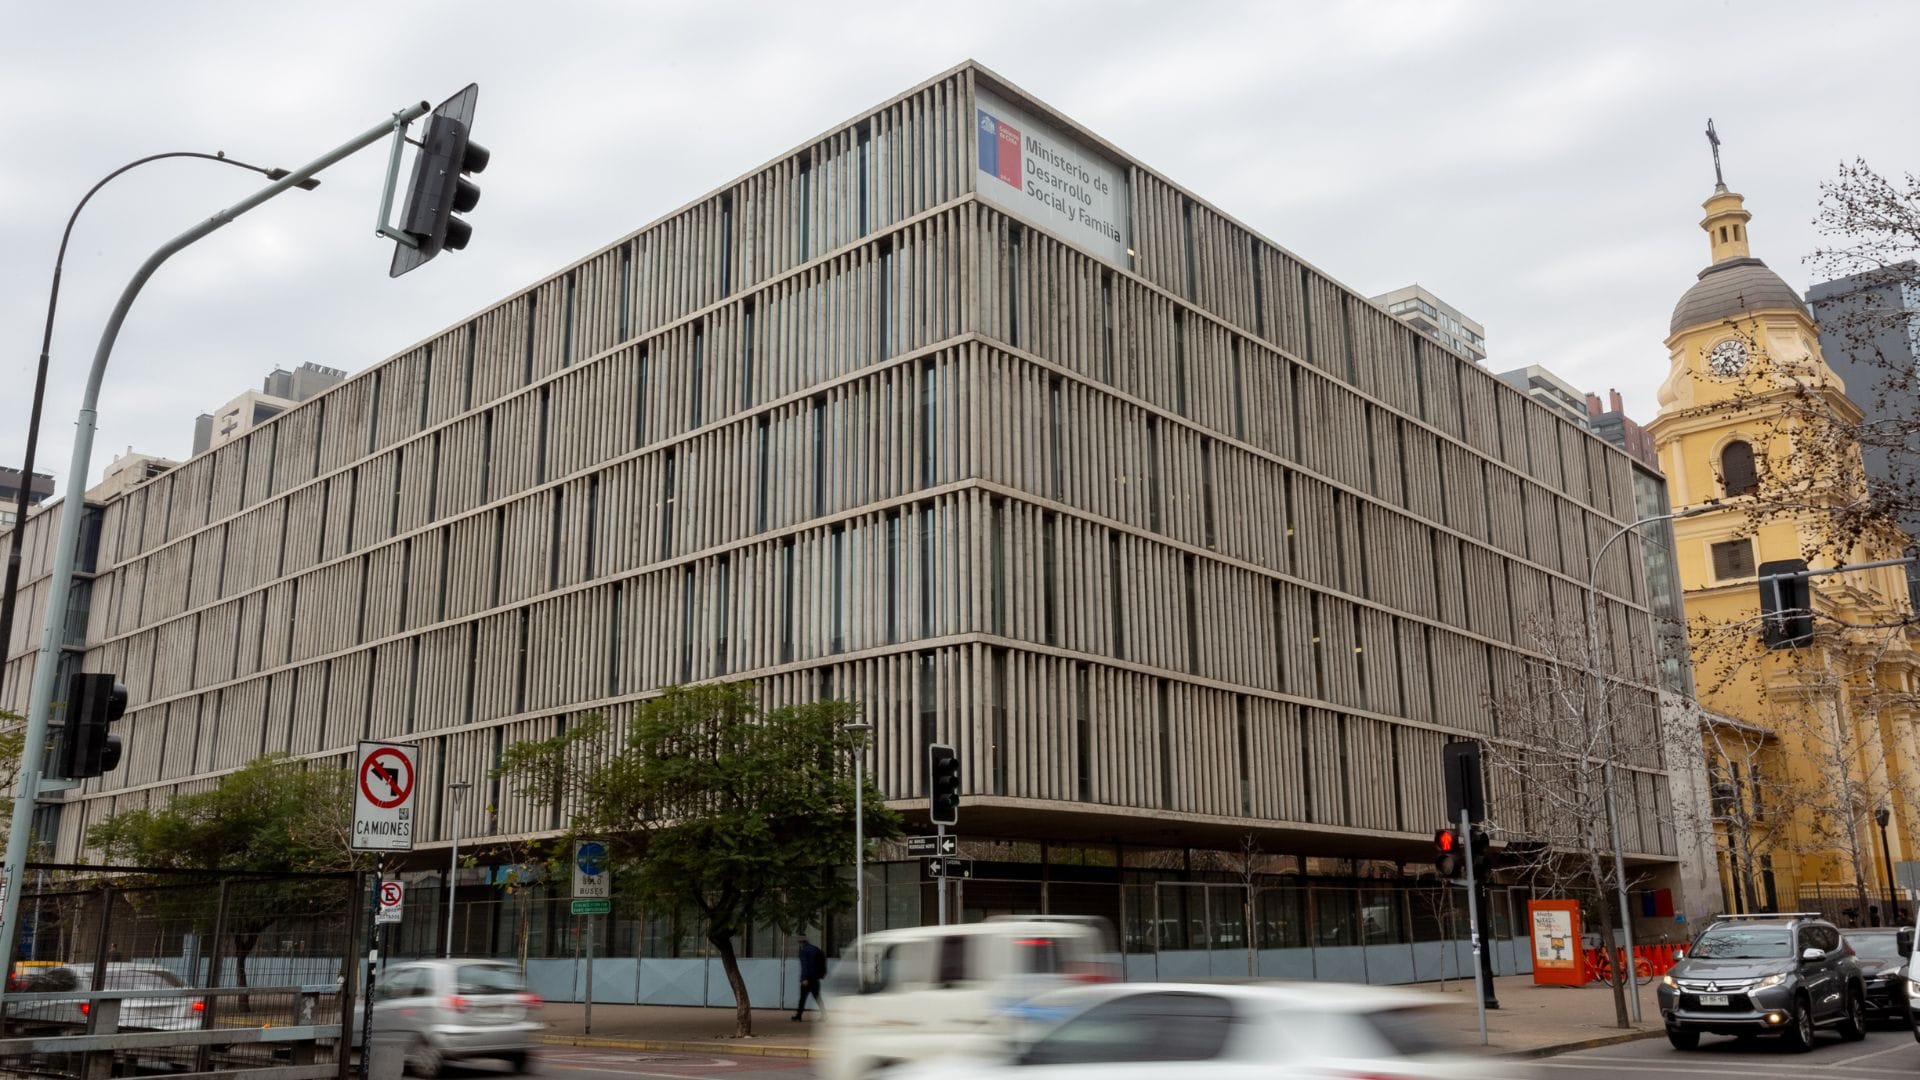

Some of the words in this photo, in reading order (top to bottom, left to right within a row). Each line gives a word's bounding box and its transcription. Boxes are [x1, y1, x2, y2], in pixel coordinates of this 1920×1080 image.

[1026, 136, 1089, 184] Ministerio
[1094, 176, 1108, 195] de
[1026, 158, 1092, 206] Desarrollo
[1027, 181, 1066, 214] Social
[1069, 206, 1076, 221] y
[1079, 208, 1121, 243] Familia
[356, 820, 410, 836] CAMIONES
[579, 887, 604, 895] BUSES
